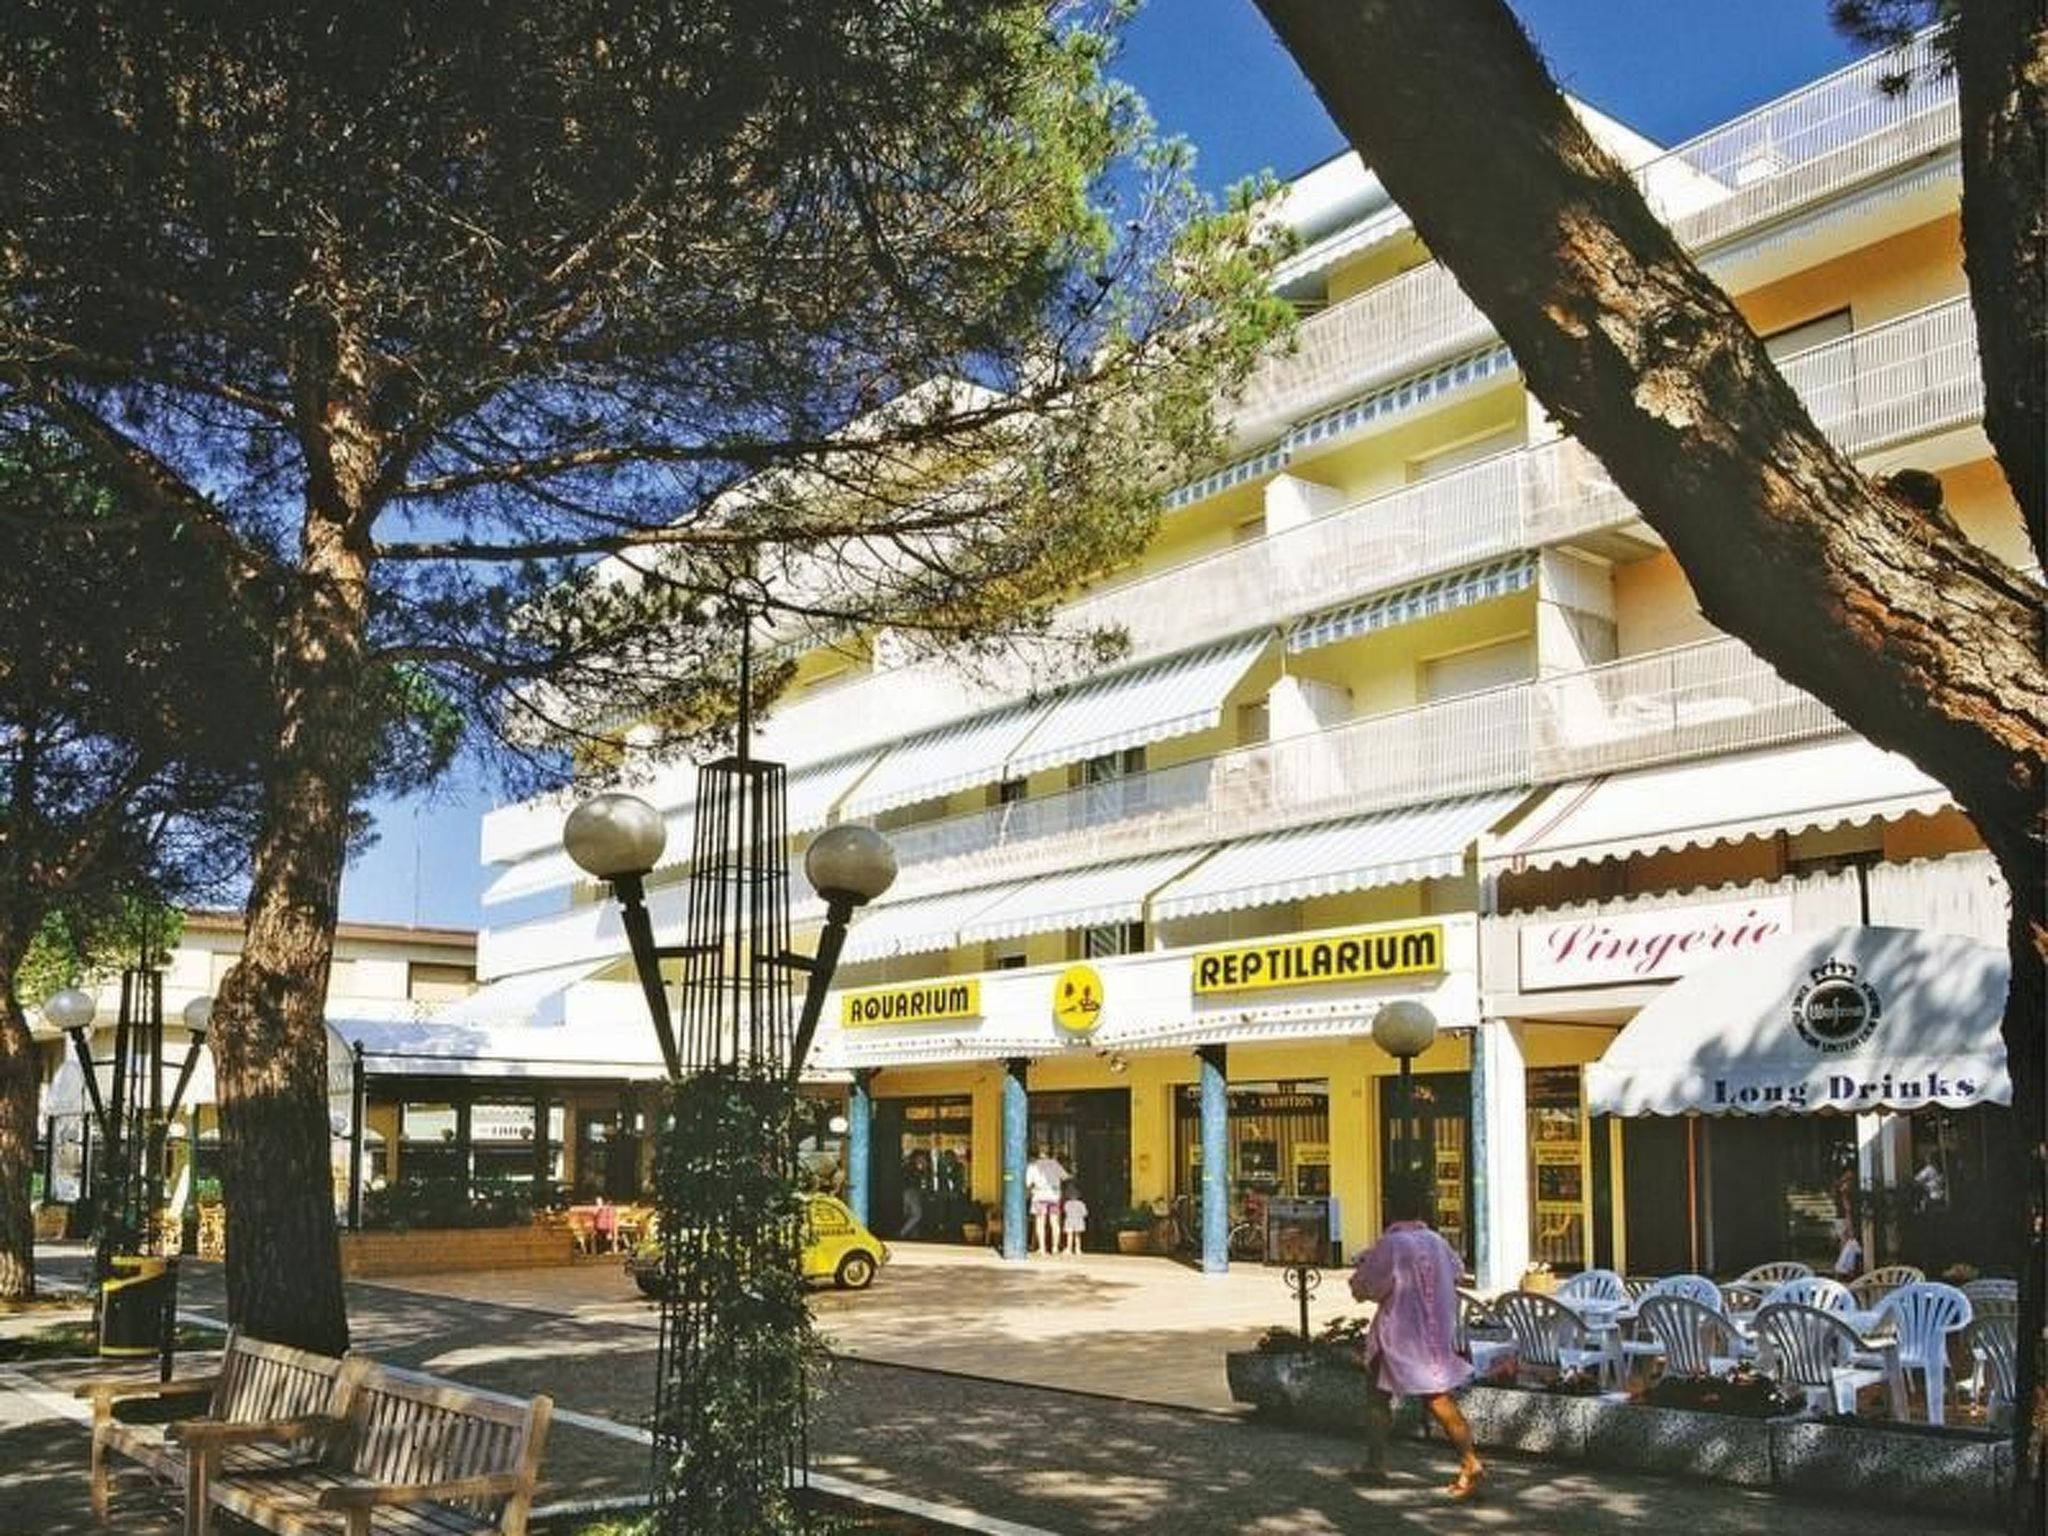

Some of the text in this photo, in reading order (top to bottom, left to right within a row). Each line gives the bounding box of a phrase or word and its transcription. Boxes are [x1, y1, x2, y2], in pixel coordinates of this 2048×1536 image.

[1200, 931, 1436, 988] REPTILARIUM
[1548, 910, 1780, 973] Lingerie
[850, 986, 969, 1022] AQUARIUM
[1714, 1073, 1976, 1107] Long Drinks
